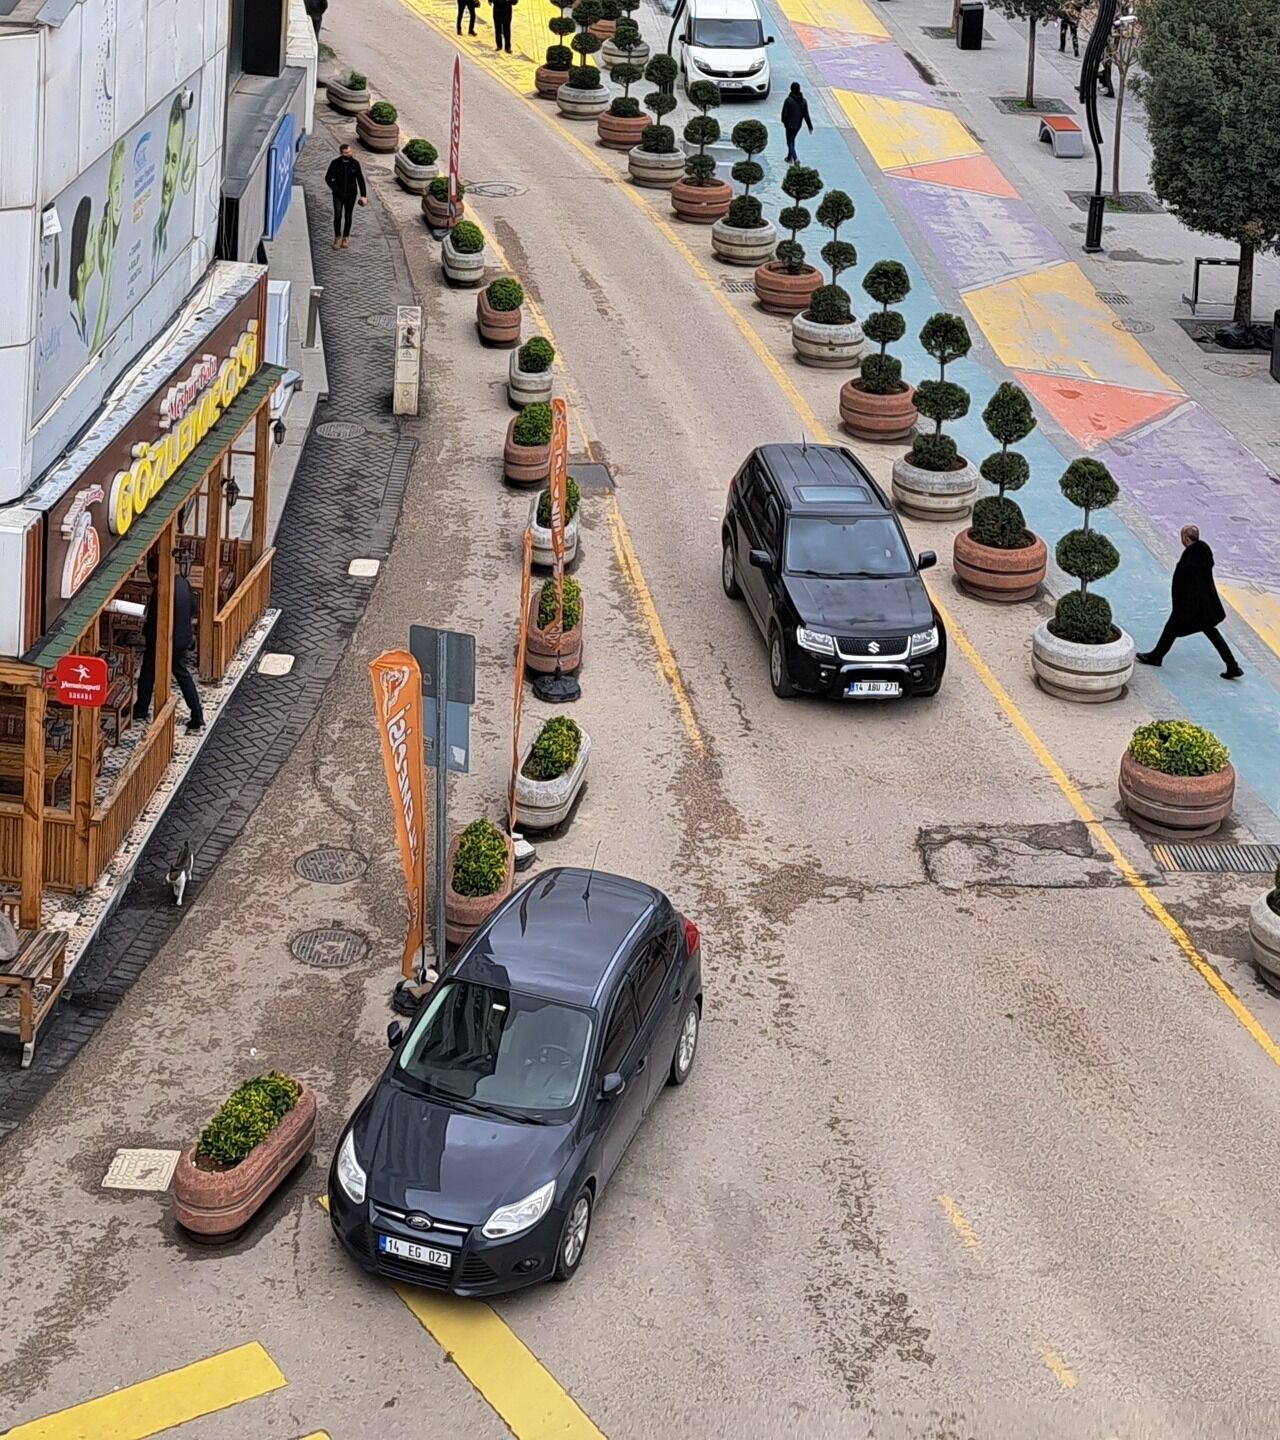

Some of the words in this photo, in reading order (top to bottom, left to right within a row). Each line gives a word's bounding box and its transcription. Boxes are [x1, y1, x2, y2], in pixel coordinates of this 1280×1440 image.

[113, 320, 258, 536] GÖZLEMECİSİ
[855, 683, 863, 691] 14
[884, 683, 898, 691] 271
[388, 1240, 399, 1253] 14
[408, 1245, 422, 1259] EG
[428, 1250, 449, 1266] 023
